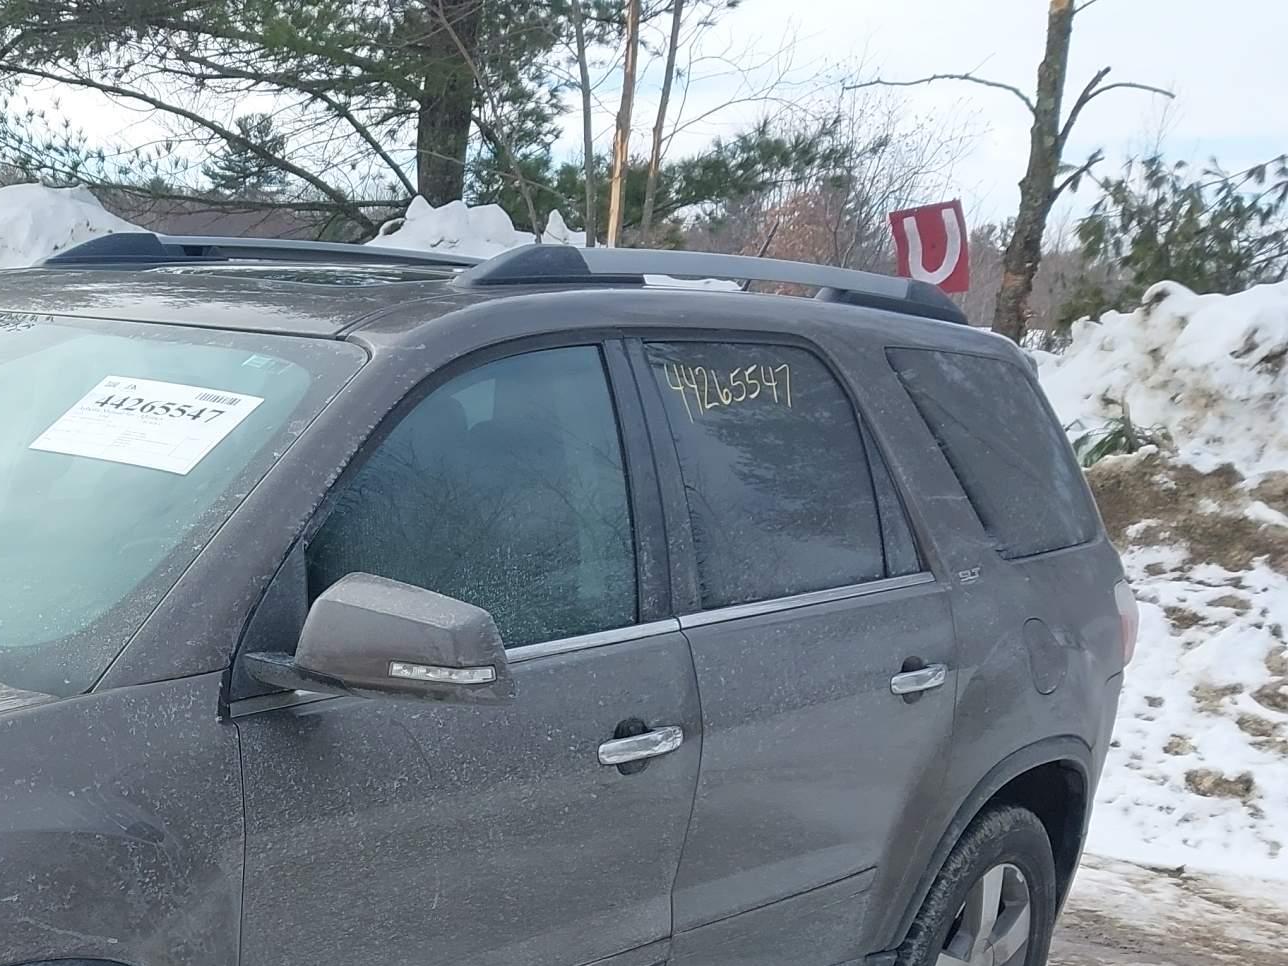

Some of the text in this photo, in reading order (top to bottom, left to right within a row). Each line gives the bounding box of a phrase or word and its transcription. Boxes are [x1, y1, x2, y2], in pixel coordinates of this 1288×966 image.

[903, 208, 961, 285] U
[95, 394, 225, 424] 44265547
[663, 363, 792, 424] 44265547
